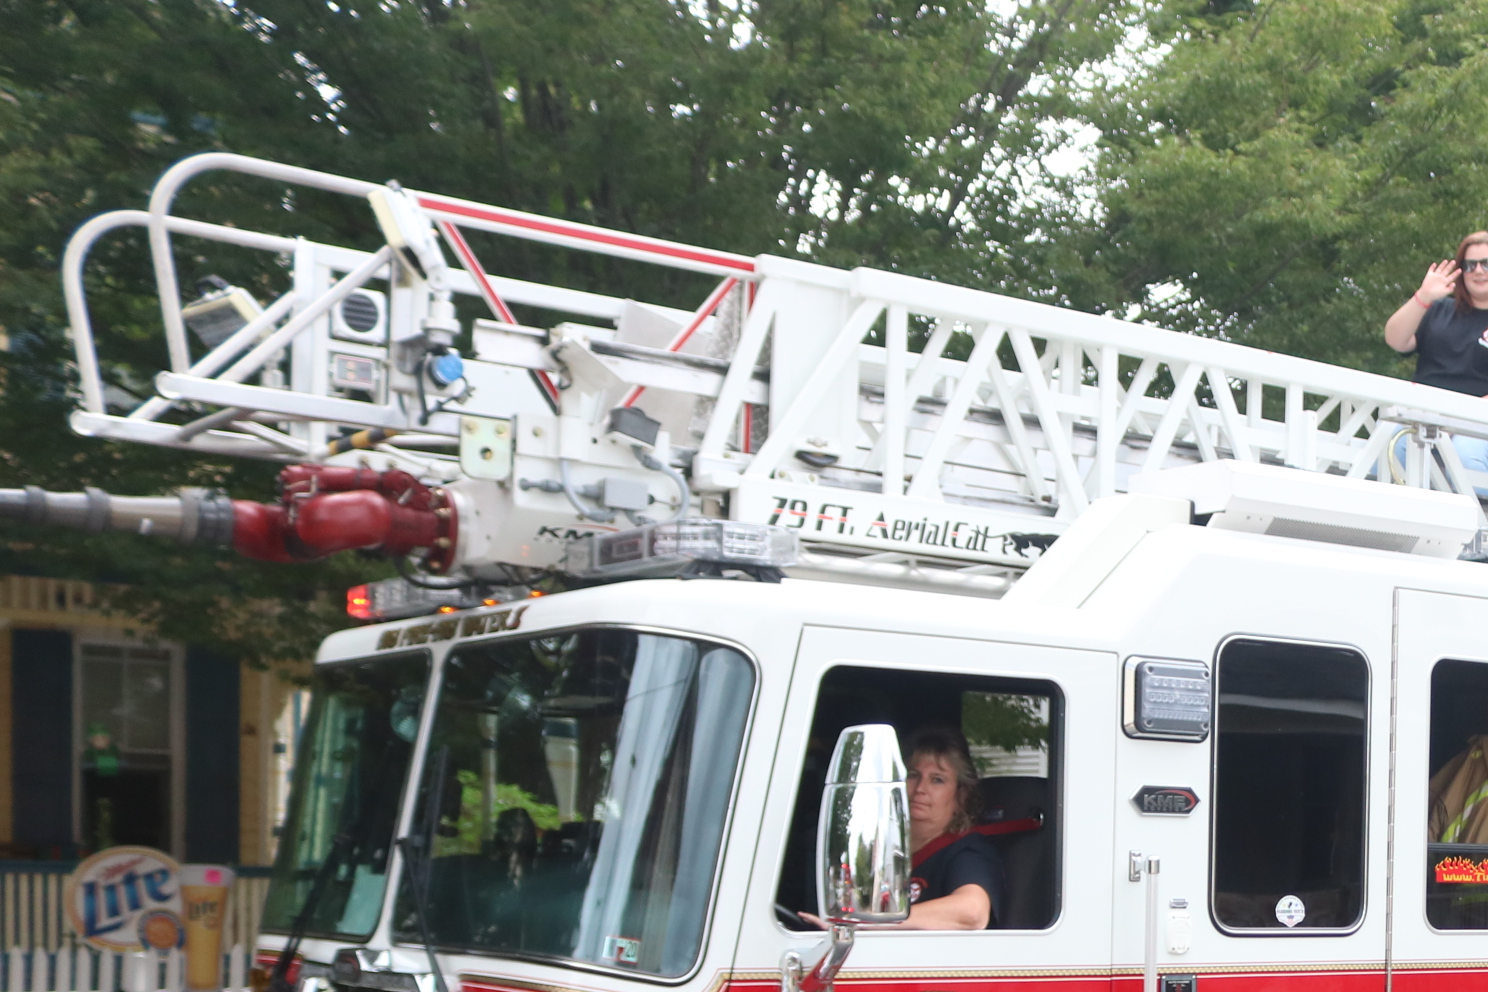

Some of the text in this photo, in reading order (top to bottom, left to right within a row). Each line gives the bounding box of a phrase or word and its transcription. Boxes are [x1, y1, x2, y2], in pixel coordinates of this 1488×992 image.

[766, 495, 808, 529] 79
[865, 510, 991, 552] AerialCat
[83, 867, 174, 938] Lite
